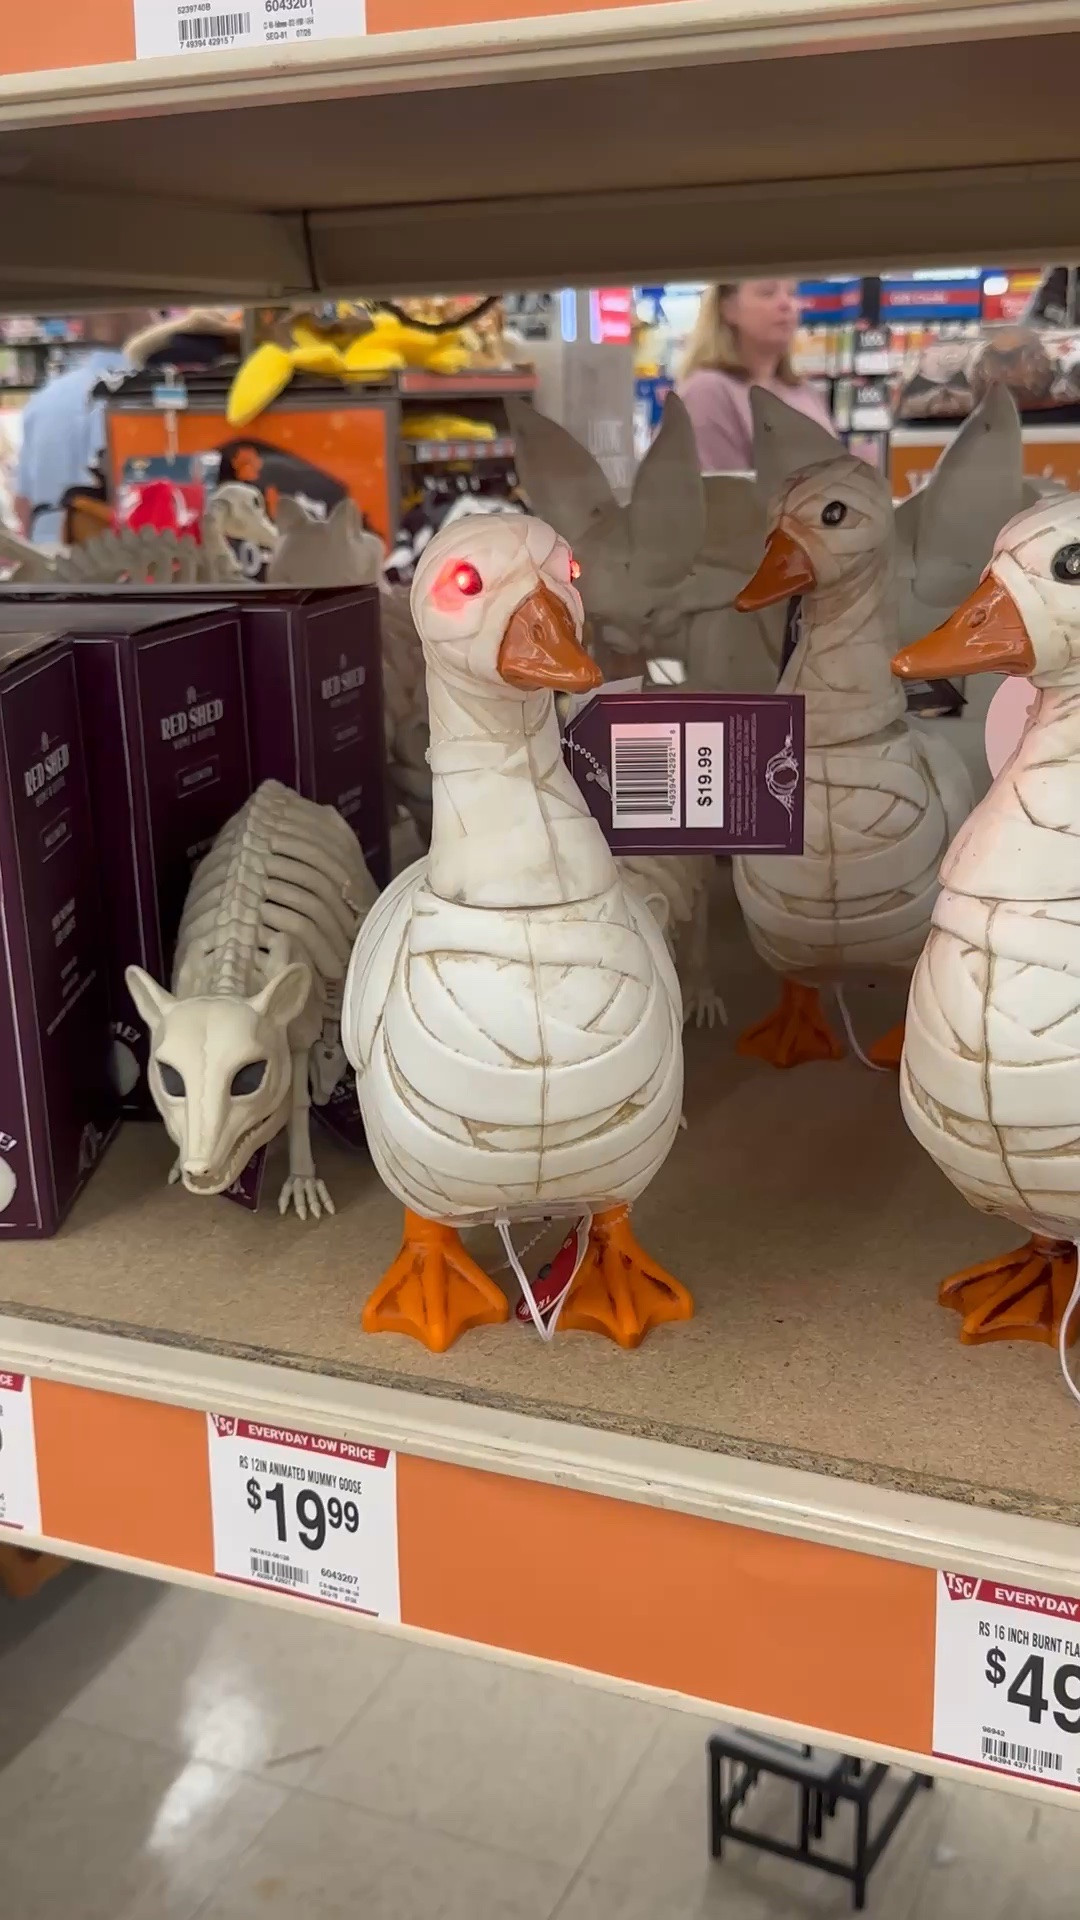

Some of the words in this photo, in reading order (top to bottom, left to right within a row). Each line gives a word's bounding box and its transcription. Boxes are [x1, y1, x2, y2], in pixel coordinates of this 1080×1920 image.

[160, 712, 188, 741] RED
[188, 699, 224, 730] SHED
[696, 746, 713, 807] $19.99
[213, 1414, 234, 1435] TSC
[248, 1424, 308, 1446] EVERYDAY
[311, 1437, 337, 1452] LOW
[340, 1445, 376, 1462] PRICE
[239, 1455, 248, 1469] RS
[251, 1457, 267, 1473] 12IN
[269, 1460, 306, 1481] ANIMATED
[307, 1471, 337, 1489] MUMMY
[339, 1477, 362, 1495] GOOSE
[320, 1567, 359, 1585] 6043207
[946, 1572, 973, 1600] TSC
[994, 1587, 1079, 1616] EVERYDAY
[978, 1620, 991, 1637] RS
[994, 1624, 1005, 1641] 16
[1007, 1627, 1030, 1646] INCH
[1032, 1632, 1063, 1653] BURNT
